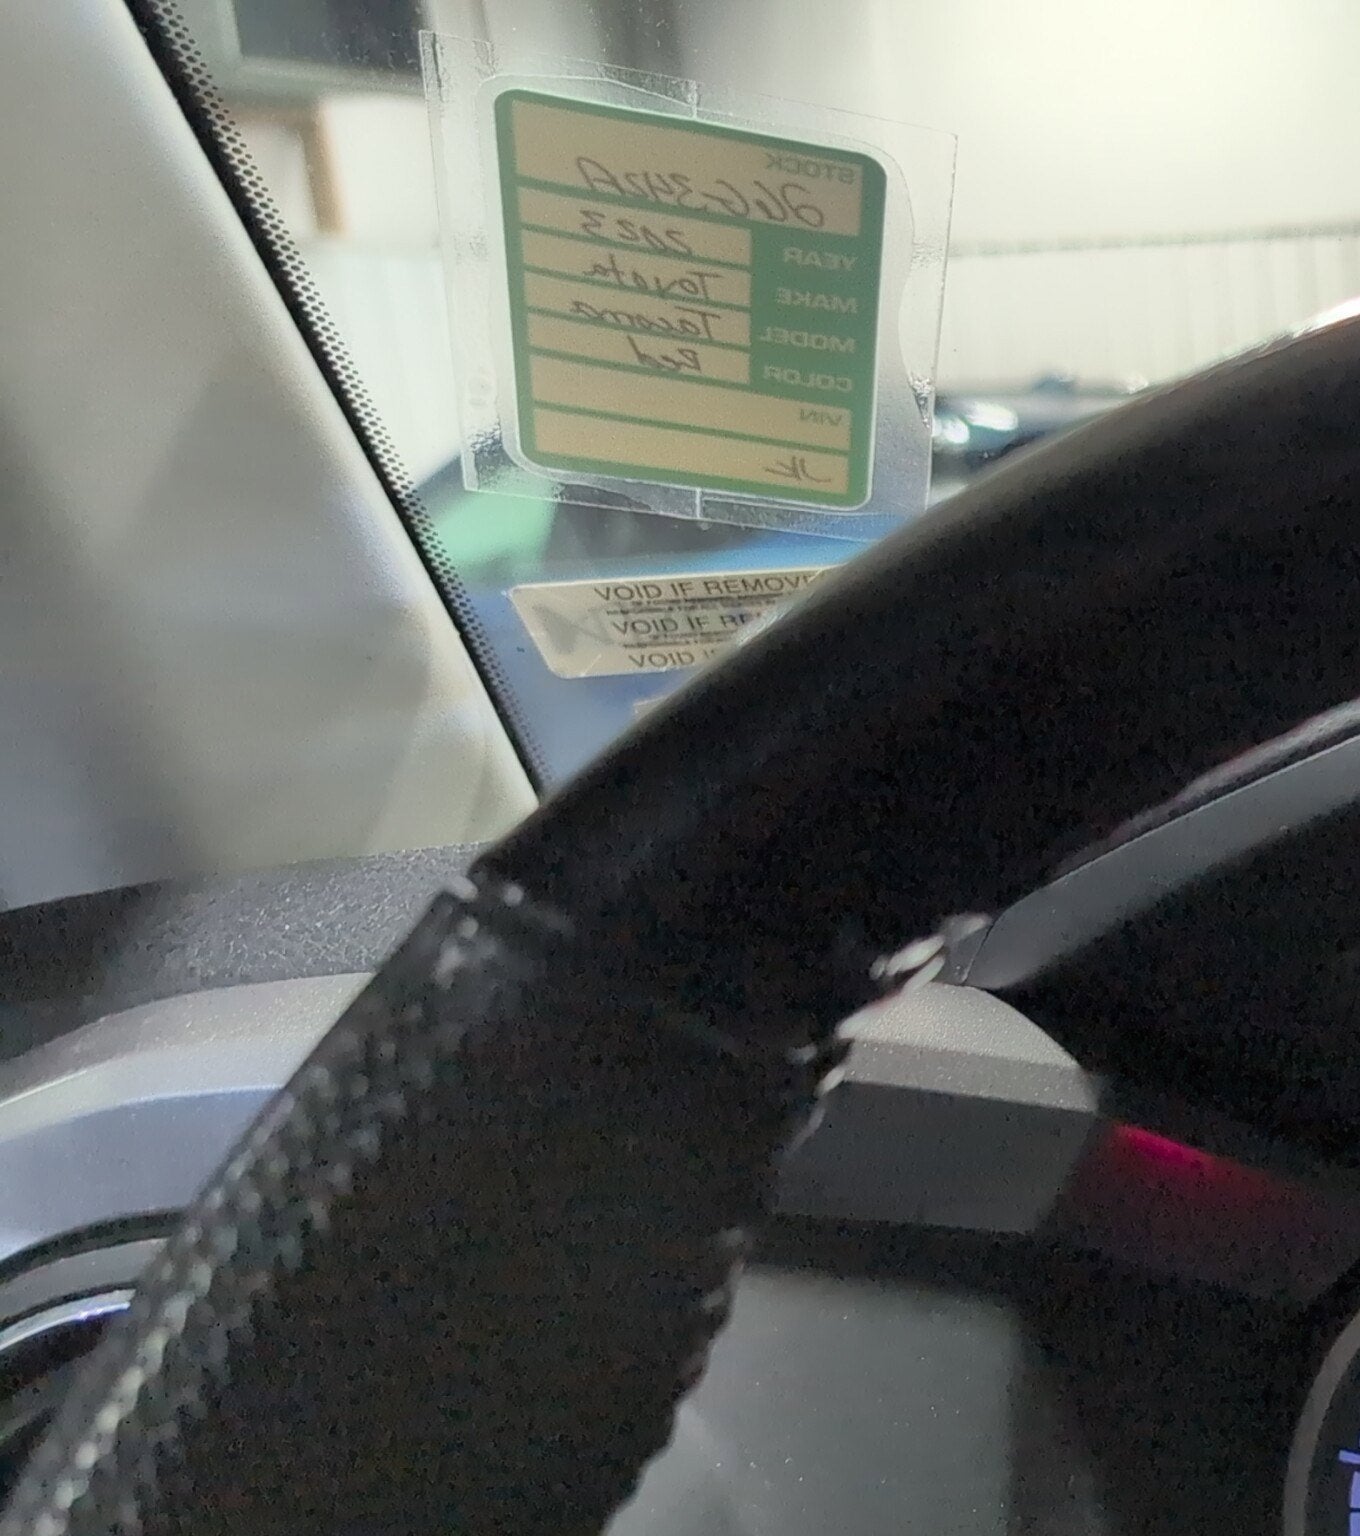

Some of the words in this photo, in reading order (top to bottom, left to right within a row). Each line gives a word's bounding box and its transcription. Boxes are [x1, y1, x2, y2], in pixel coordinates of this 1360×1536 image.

[593, 583, 662, 602] VOID
[671, 581, 695, 600] IF
[611, 617, 679, 637] VOID
[687, 615, 710, 632] IF
[628, 650, 695, 668] VOID
